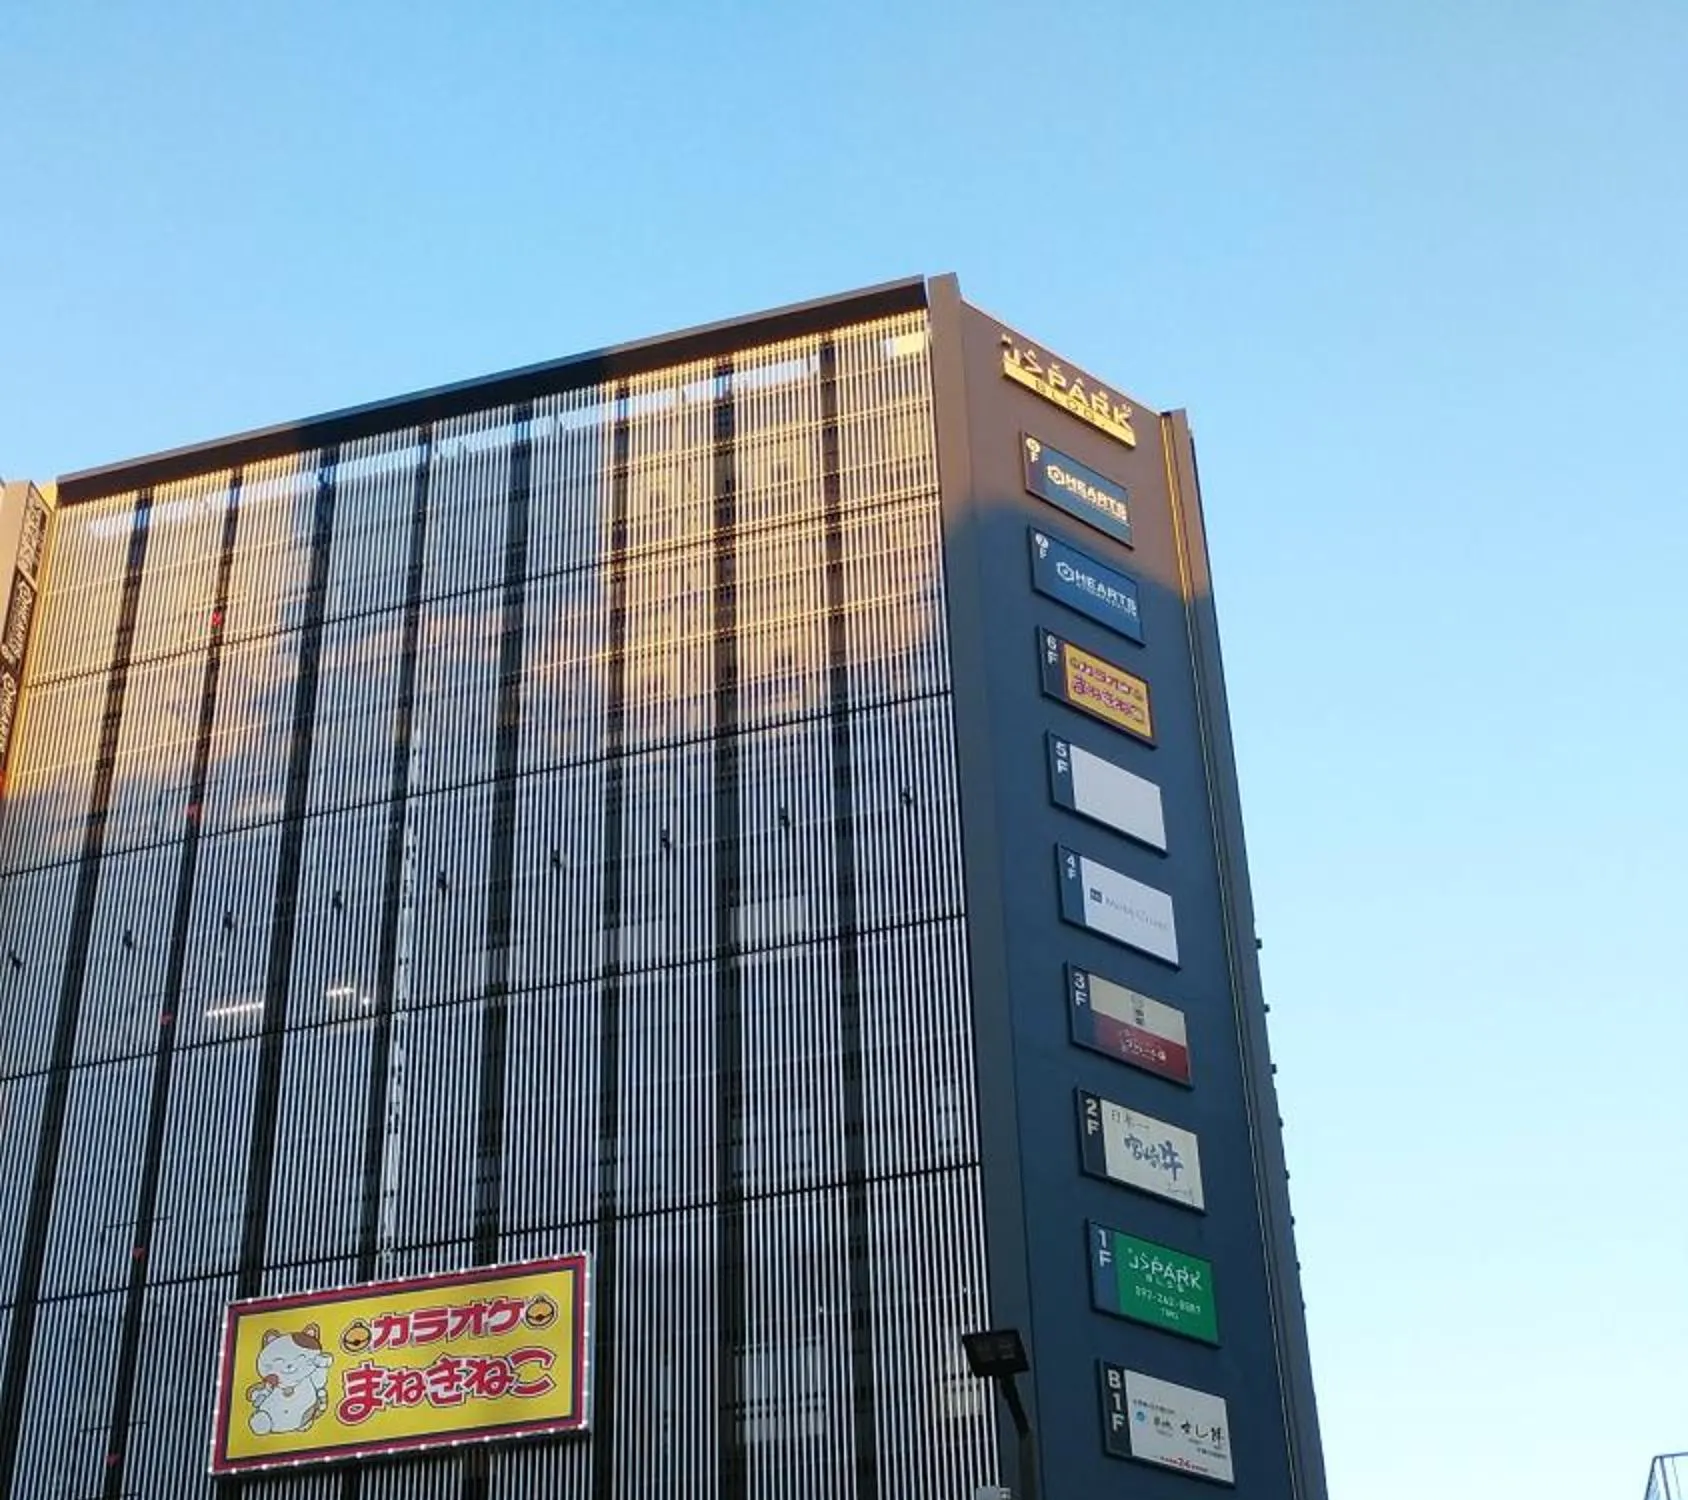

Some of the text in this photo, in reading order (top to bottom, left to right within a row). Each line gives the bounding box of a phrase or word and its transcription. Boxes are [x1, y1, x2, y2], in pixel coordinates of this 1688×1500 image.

[1056, 741, 1068, 773] 5F
[1085, 1098, 1100, 1136] 2F
[1099, 1230, 1112, 1267] 1F
[371, 1297, 527, 1350] カラオケ
[336, 1346, 556, 1425] まねきねこ
[1108, 1369, 1125, 1432] B1F
